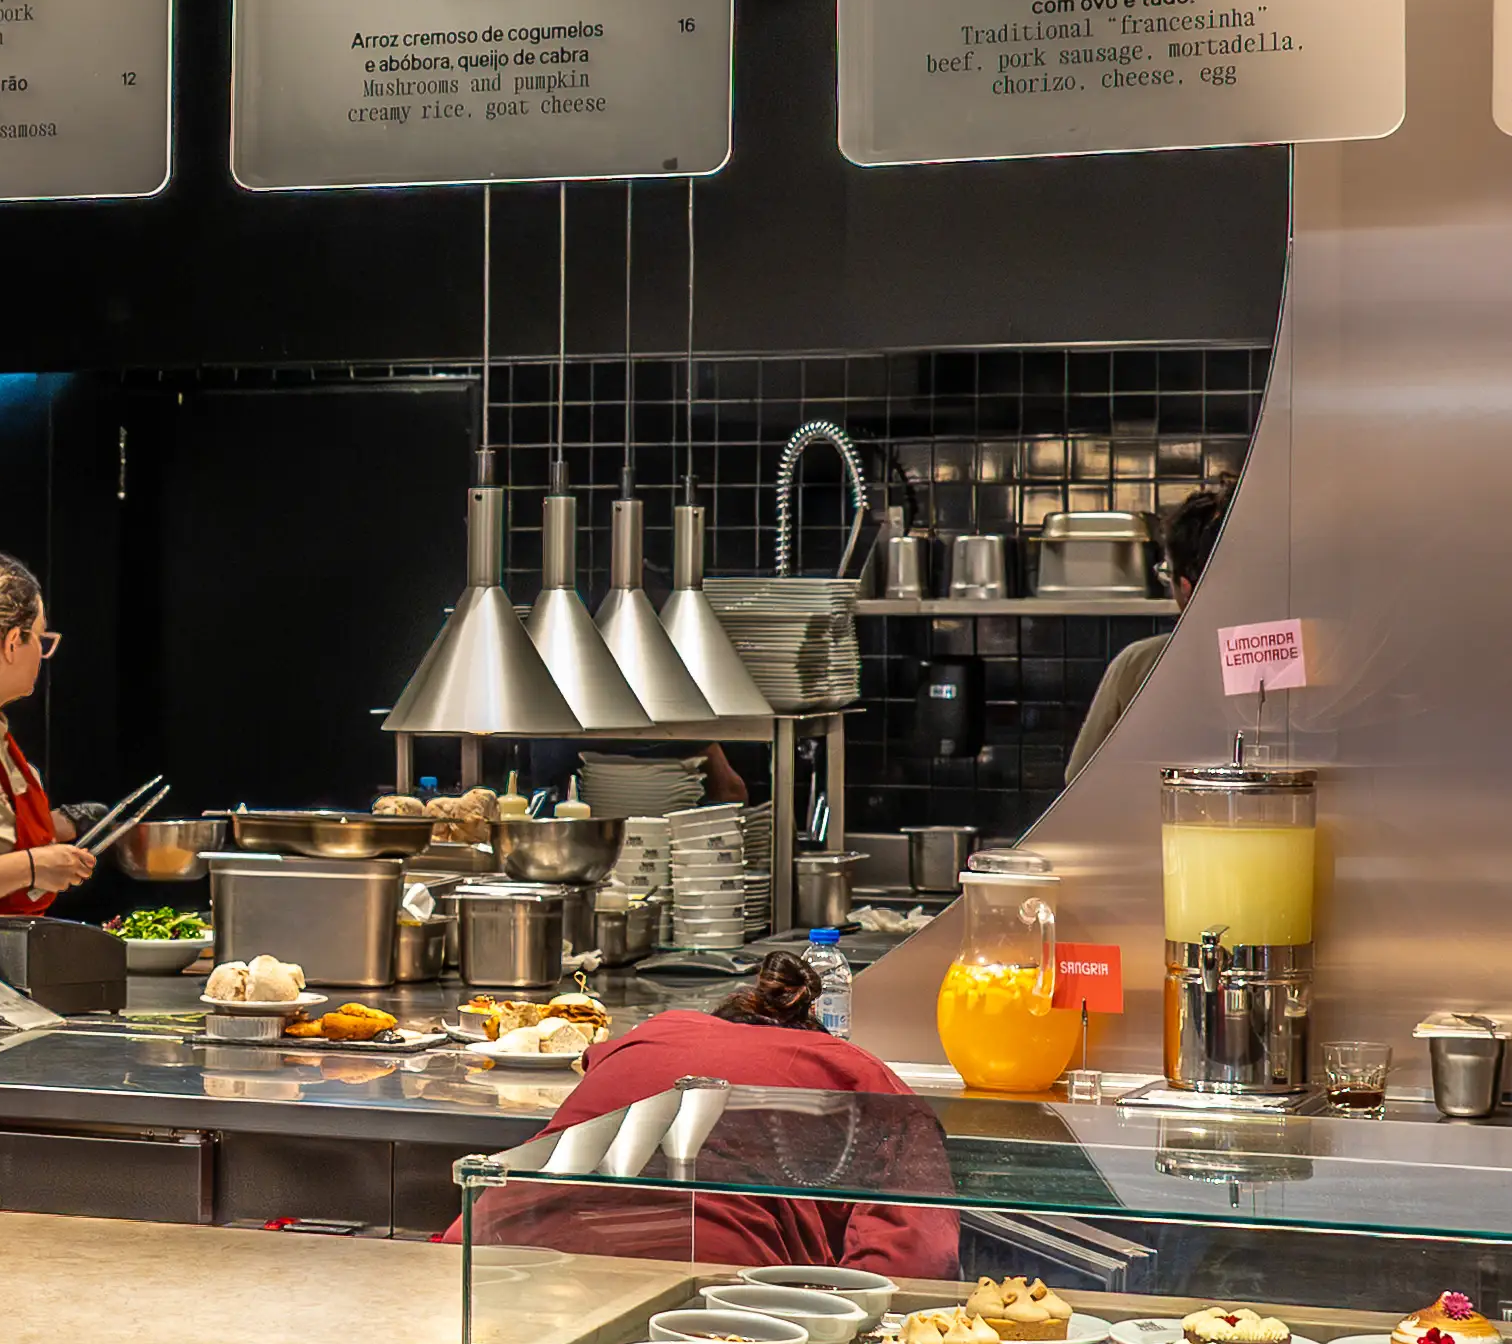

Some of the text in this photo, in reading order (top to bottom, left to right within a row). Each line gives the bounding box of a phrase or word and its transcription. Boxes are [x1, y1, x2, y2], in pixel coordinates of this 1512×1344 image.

[1226, 632, 1294, 651] LIMONADA
[1226, 647, 1298, 667] LEMONADE
[1059, 960, 1109, 975] SANGRIA
